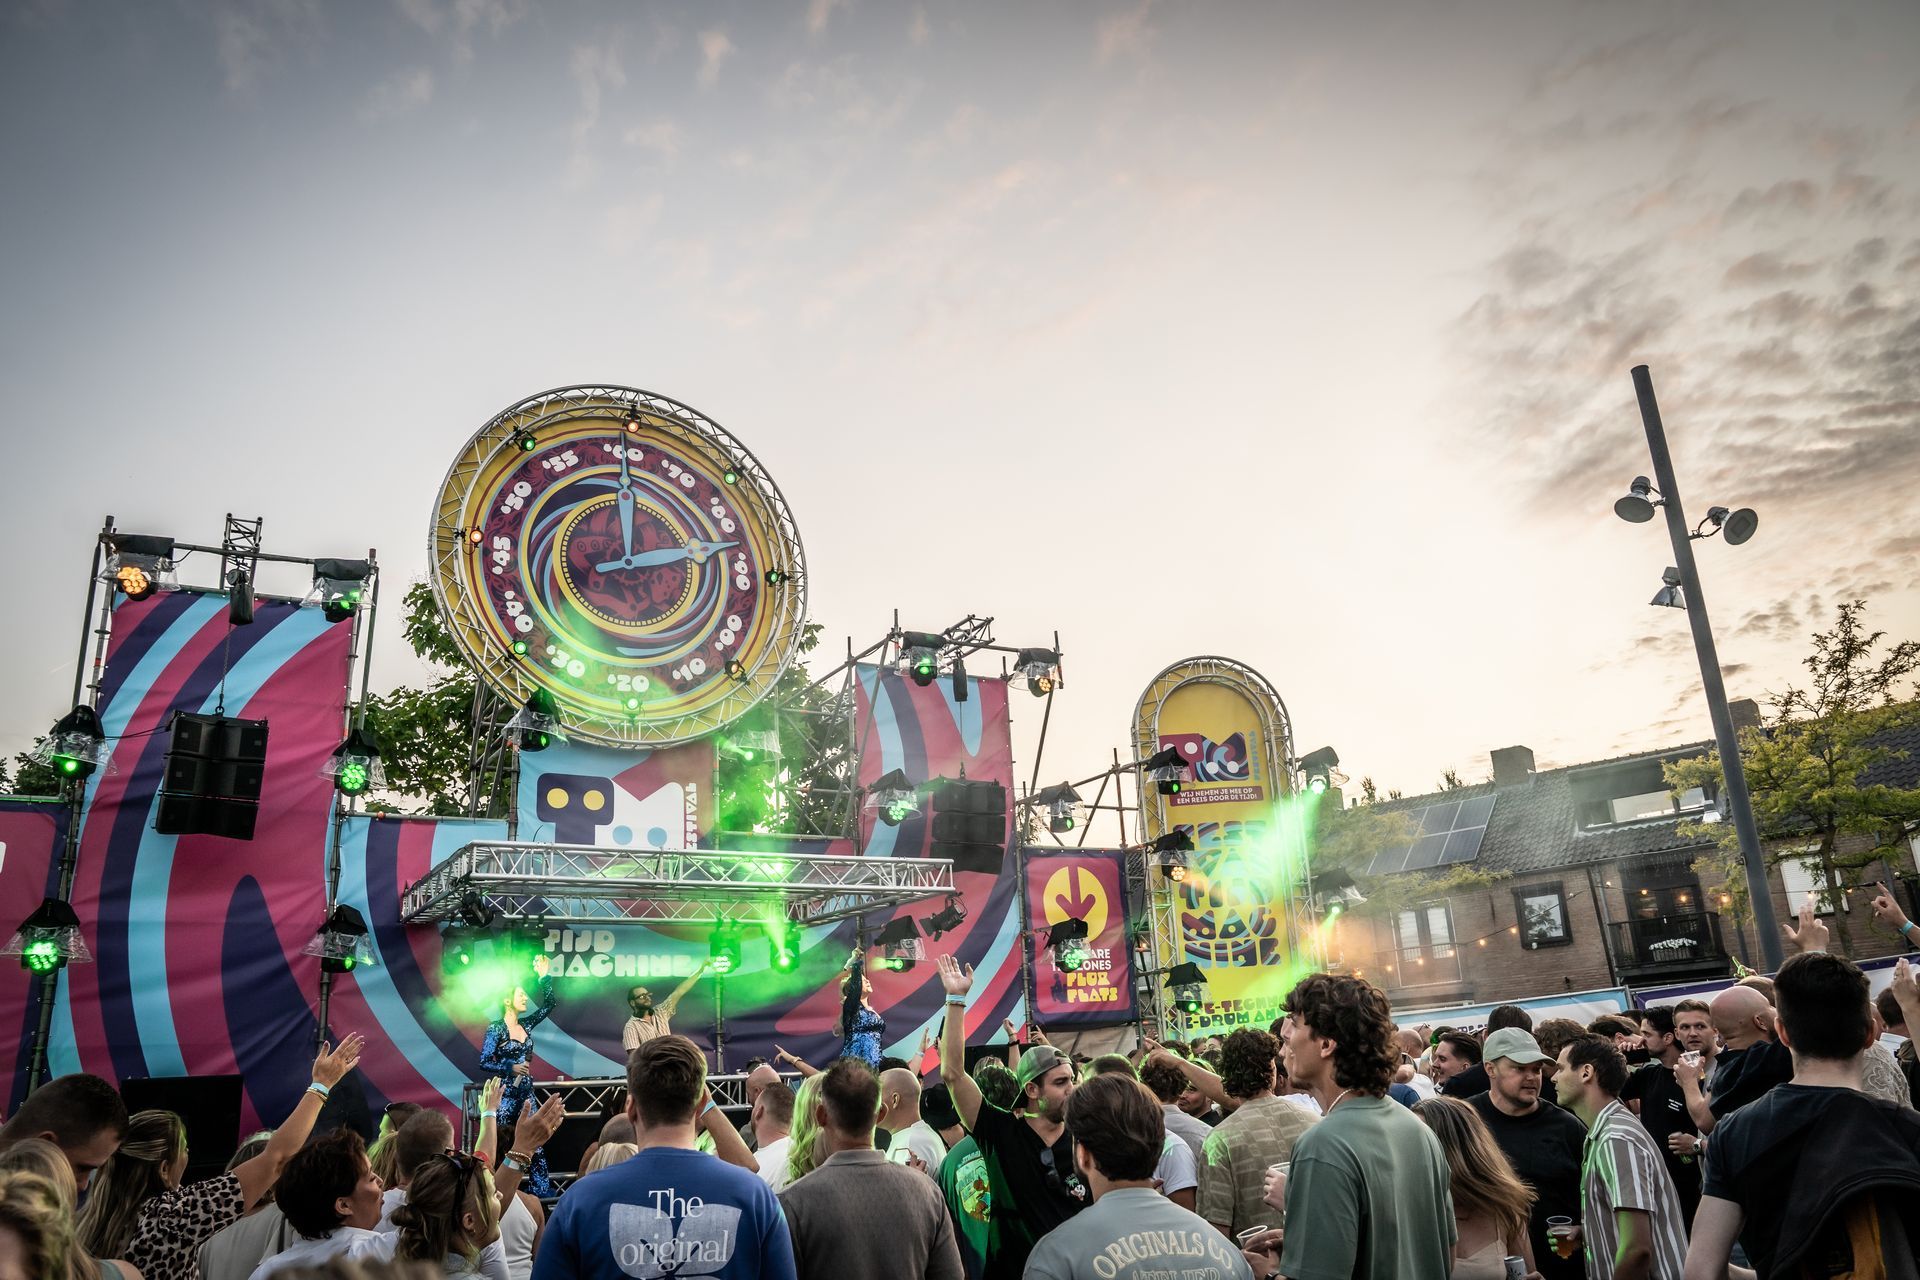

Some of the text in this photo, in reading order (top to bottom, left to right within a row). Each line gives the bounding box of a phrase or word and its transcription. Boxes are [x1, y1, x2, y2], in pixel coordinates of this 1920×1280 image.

[542, 450, 579, 472] '55
[603, 443, 644, 462] '60
[661, 459, 696, 488] '70
[500, 481, 532, 514] '50
[710, 496, 736, 533] '80
[492, 535, 512, 575] '45
[734, 552, 750, 591] '90
[504, 591, 533, 632] '40
[715, 614, 743, 651] '00
[546, 645, 585, 678] '30
[672, 657, 706, 681] '10
[607, 674, 649, 692] '20
[1177, 797, 1190, 805] EEN
[648, 1188, 704, 1220] The
[620, 1230, 729, 1272] original
[1092, 1229, 1205, 1279] ORIGINALS
